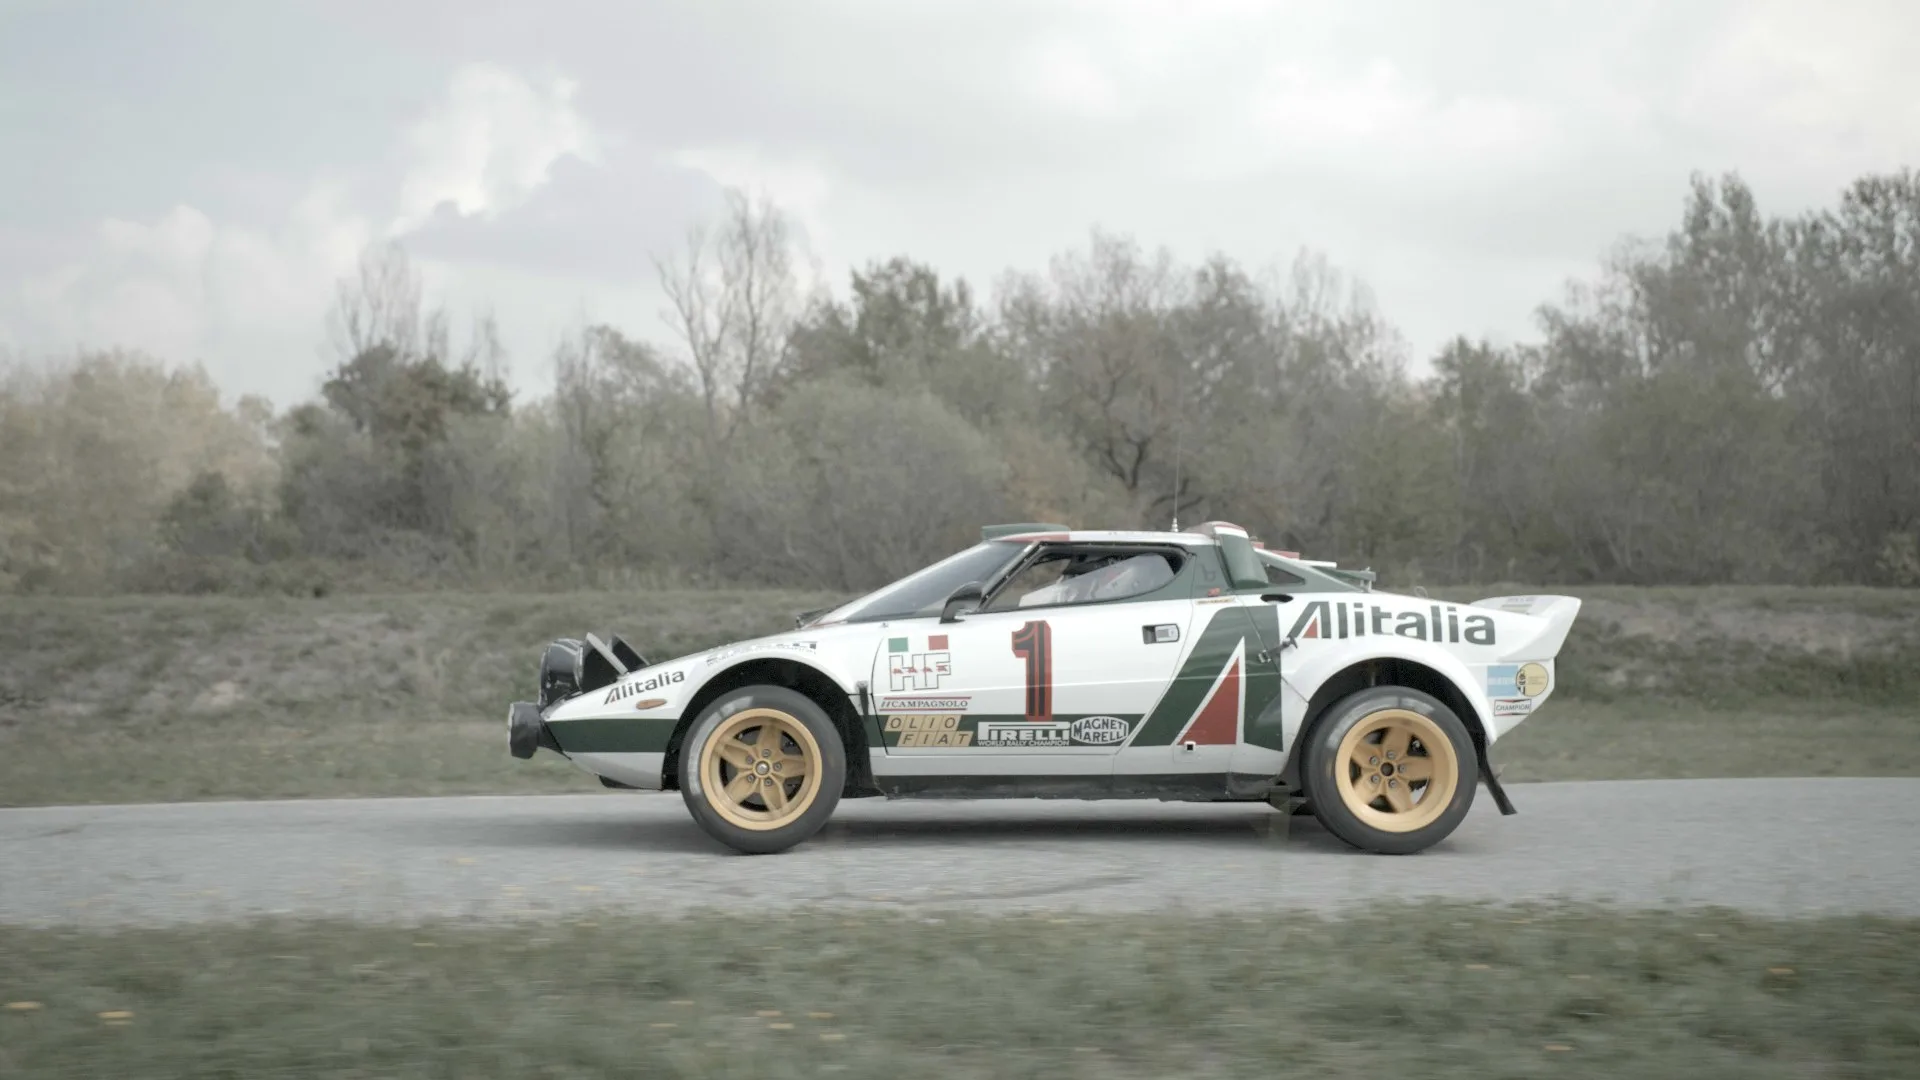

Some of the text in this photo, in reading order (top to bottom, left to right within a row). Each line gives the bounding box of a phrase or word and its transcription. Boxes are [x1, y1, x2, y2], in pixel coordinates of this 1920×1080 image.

[1287, 601, 1496, 645] Alitalia
[889, 652, 951, 691] HF
[1012, 620, 1052, 722] 1
[604, 670, 685, 705] Alitalia
[1496, 704, 1530, 712] CHAMPION
[890, 717, 956, 729] OLIO
[978, 721, 1070, 741] PIRELLI
[902, 733, 969, 744] FIAT
